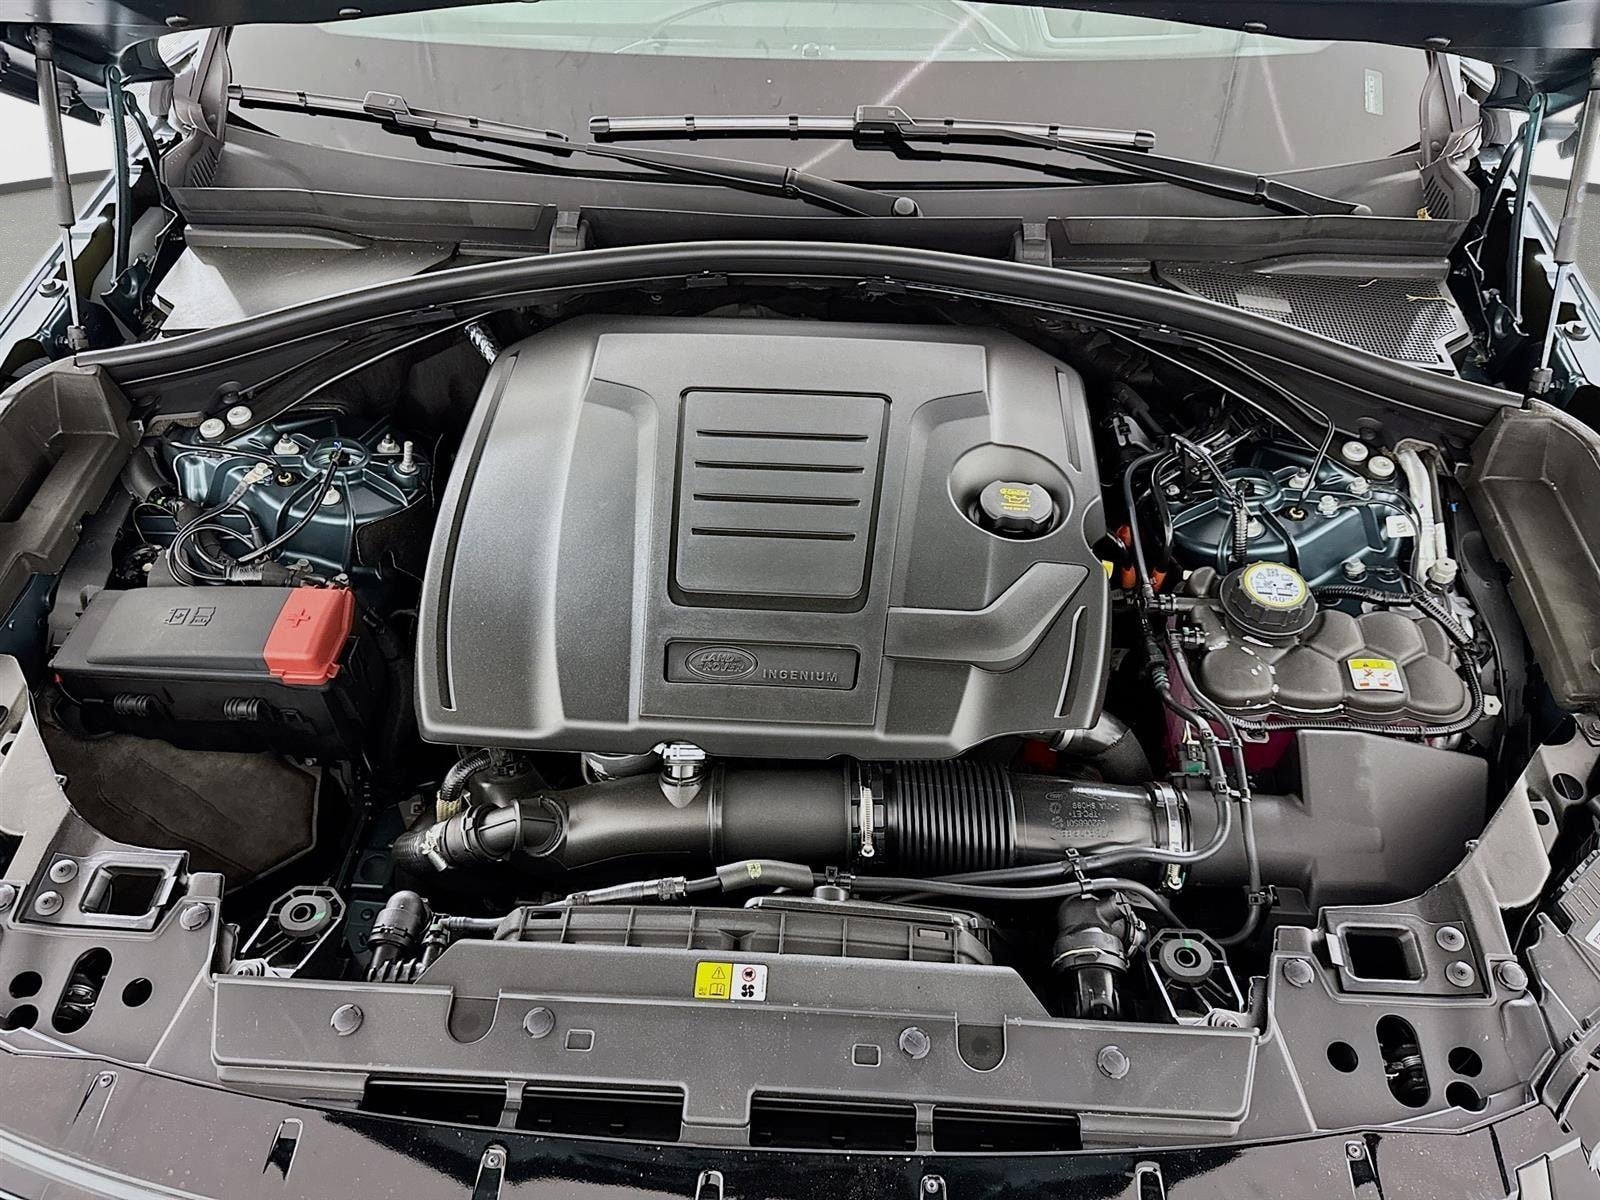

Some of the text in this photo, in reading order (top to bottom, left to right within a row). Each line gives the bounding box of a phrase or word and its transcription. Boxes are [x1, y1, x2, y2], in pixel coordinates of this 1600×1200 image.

[701, 652, 736, 662] LAND
[703, 661, 744, 672] ROVER
[762, 668, 839, 683] INGENIUM
